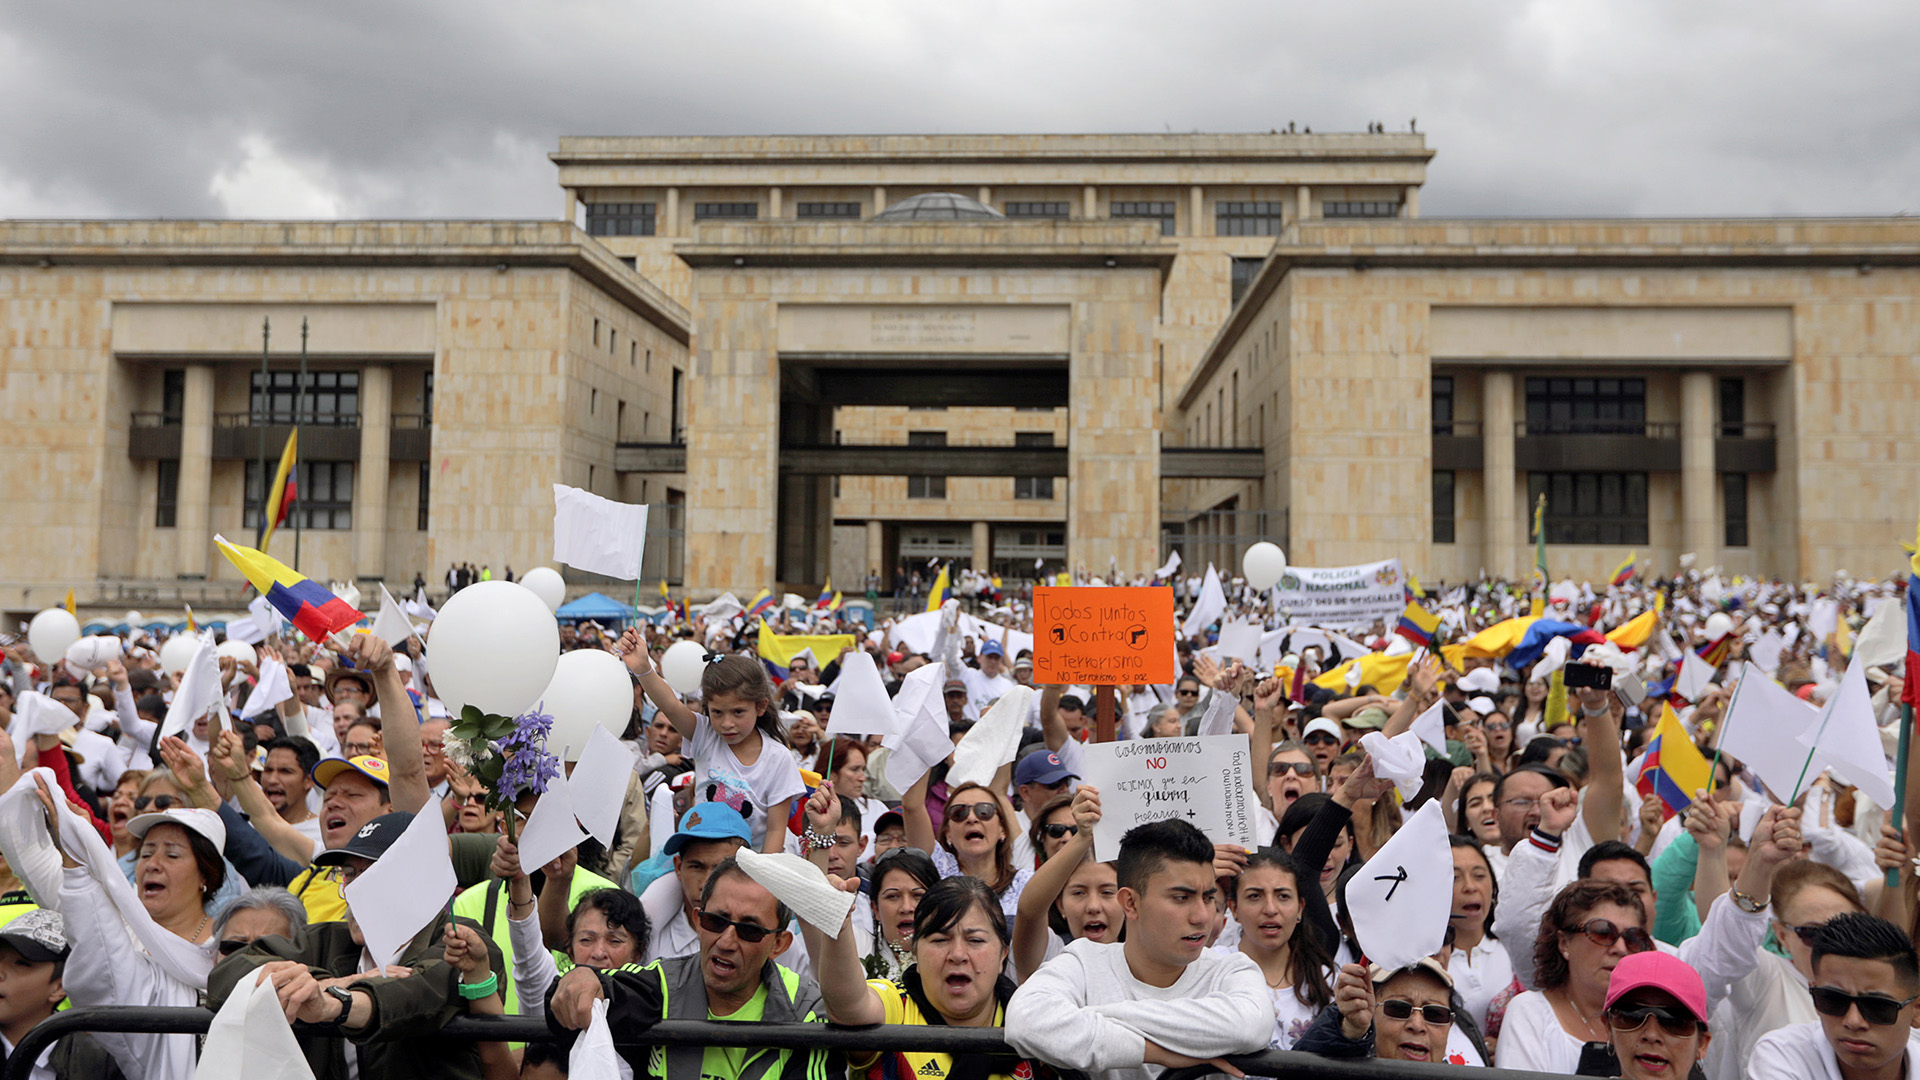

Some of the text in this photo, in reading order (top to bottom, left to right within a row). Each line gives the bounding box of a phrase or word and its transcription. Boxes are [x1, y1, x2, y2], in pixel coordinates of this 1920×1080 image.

[1312, 569, 1360, 579] POLICIA
[1305, 580, 1368, 593] NACIONAL
[1036, 594, 1147, 627] Todos juntos
[1038, 650, 1143, 671] el terrorismo
[1056, 672, 1070, 682] NO
[1146, 757, 1167, 770] NO
[1117, 779, 1155, 792] DEJEMOS
[1139, 789, 1191, 807] guerra
[917, 1068, 945, 1077] adidas
